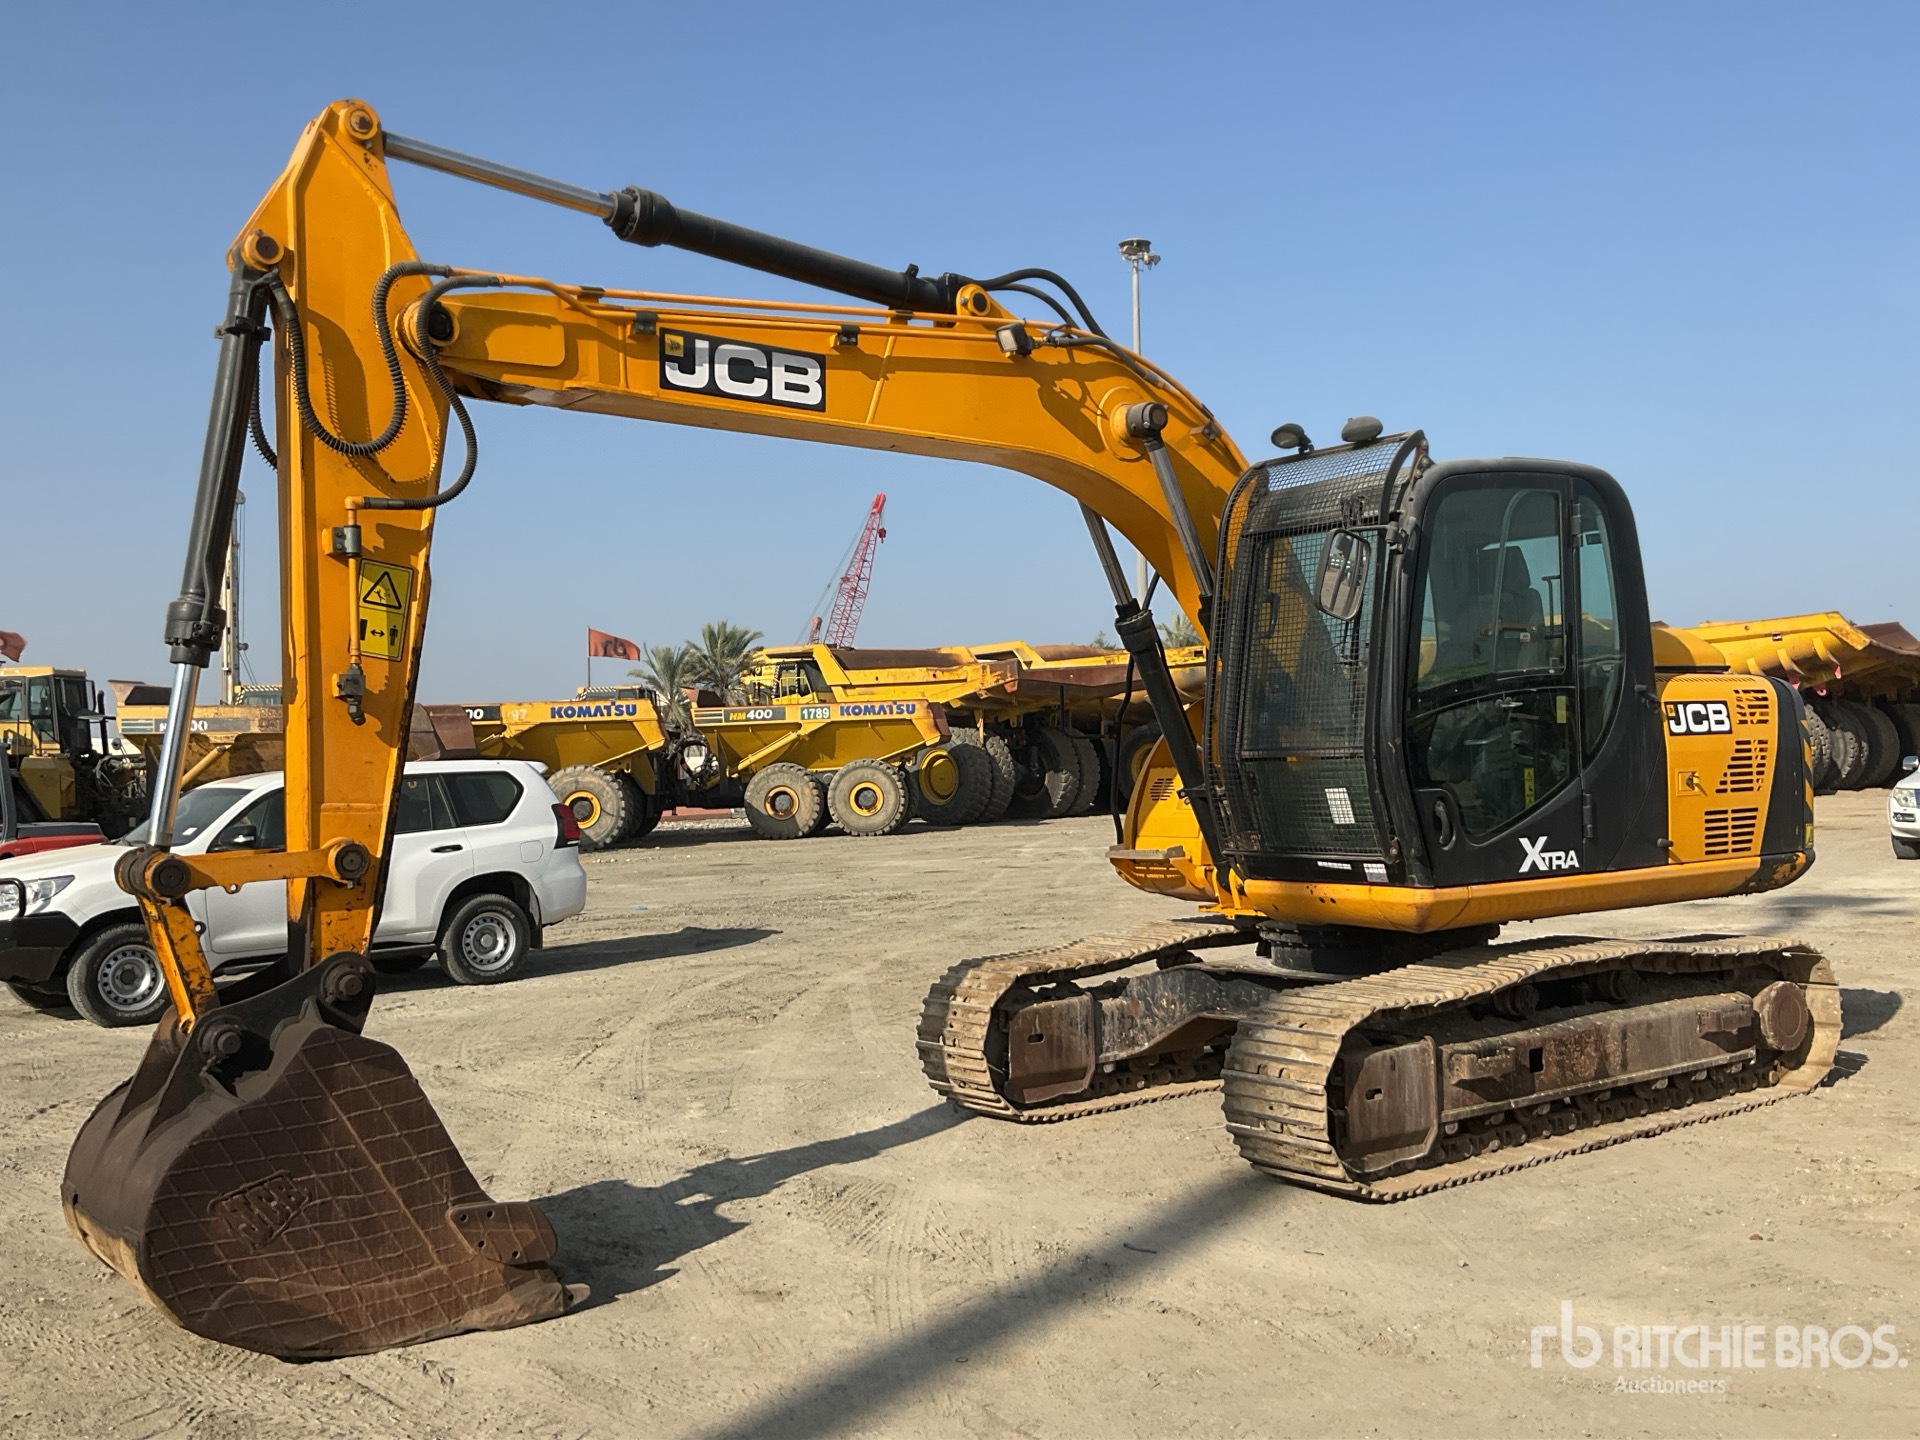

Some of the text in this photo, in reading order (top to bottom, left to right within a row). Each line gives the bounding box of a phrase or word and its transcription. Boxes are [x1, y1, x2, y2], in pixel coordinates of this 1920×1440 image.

[664, 339, 823, 405] JCB
[551, 701, 637, 719] KOMATSU
[802, 708, 830, 719] 1789
[840, 701, 916, 716] KOMATSU
[1669, 703, 1731, 733] JCB
